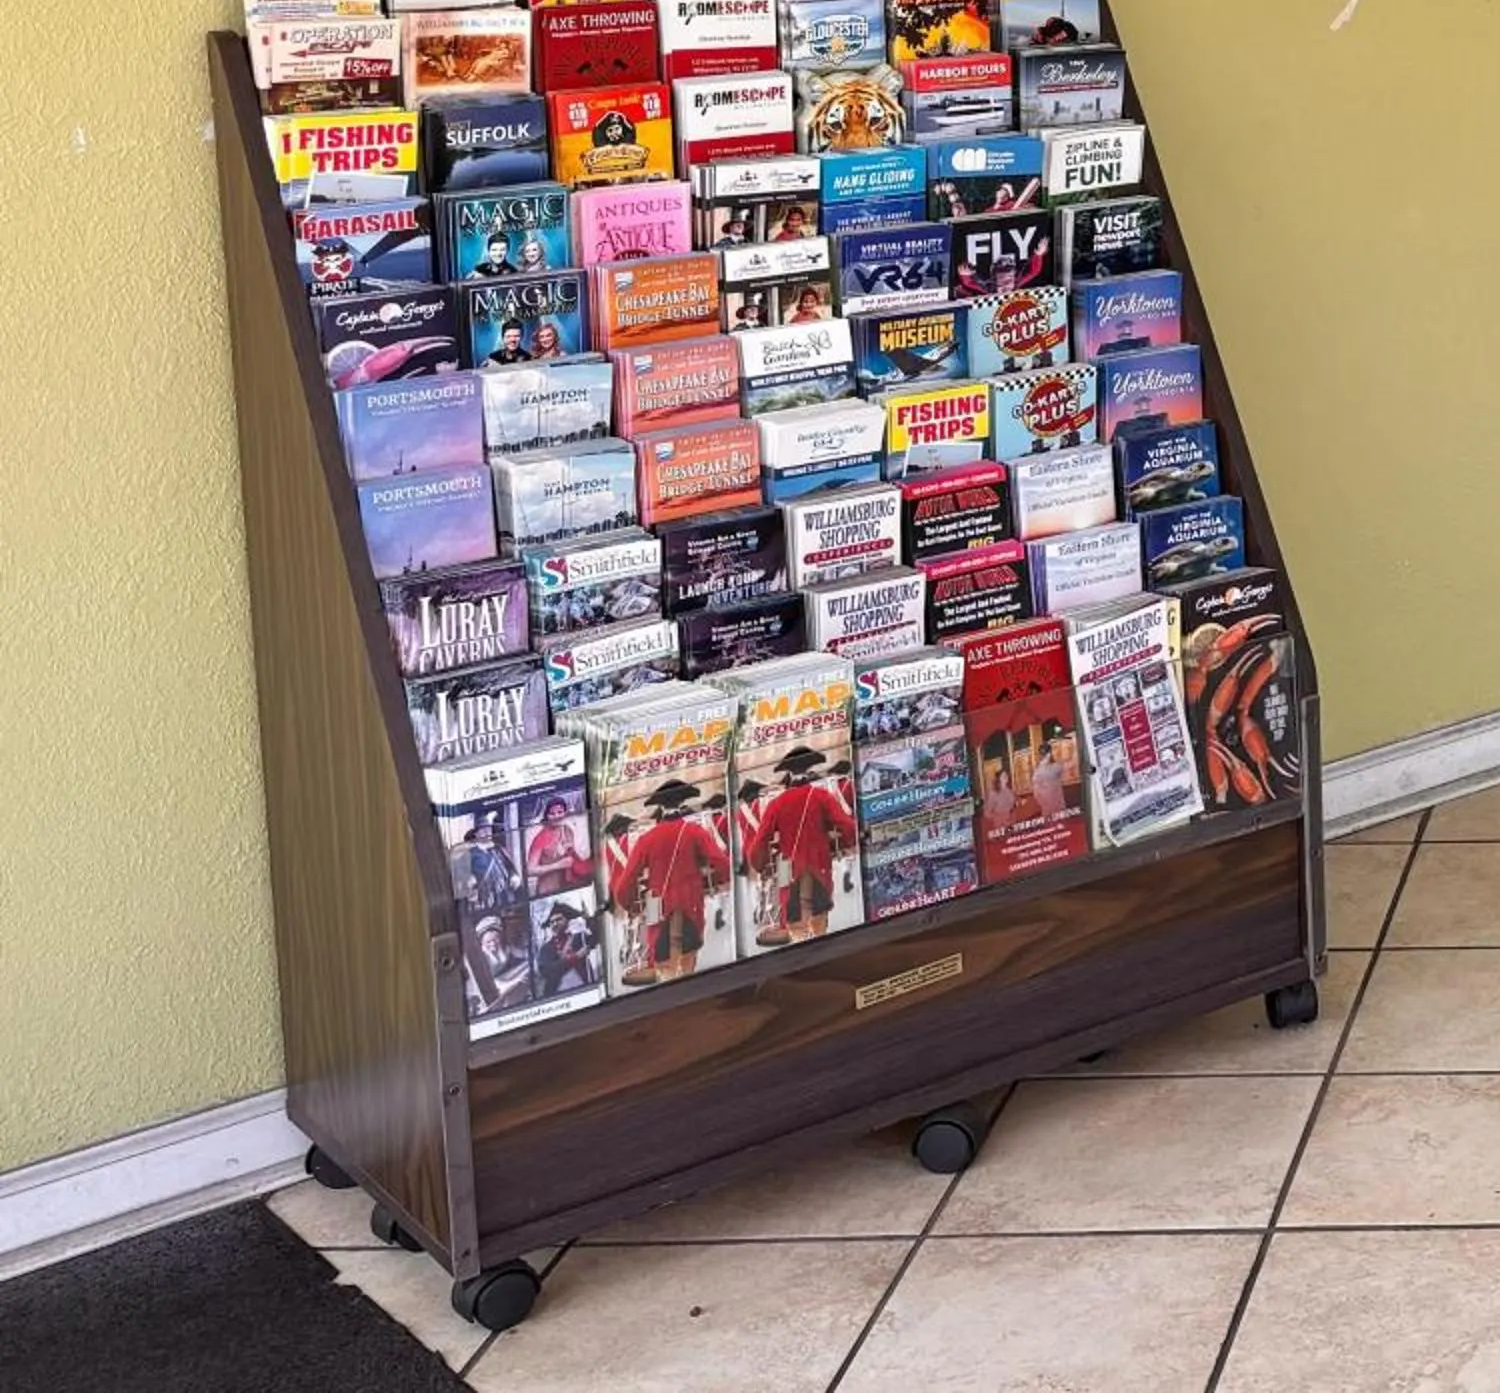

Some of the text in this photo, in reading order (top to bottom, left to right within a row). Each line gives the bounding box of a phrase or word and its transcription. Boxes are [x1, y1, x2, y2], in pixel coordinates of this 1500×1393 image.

[290, 24, 394, 44] OPERATION
[549, 9, 655, 31] AXE THROWING
[805, 21, 869, 42] GLOUCESTER
[918, 62, 1008, 80] HARBOR TOURS
[1040, 60, 1120, 83] Berkeley
[298, 122, 415, 151] FISHING
[445, 122, 530, 147] SUFFOLK
[1065, 138, 1123, 154] ZIPLINE &
[312, 148, 400, 173] TRIPS
[1065, 148, 1123, 166] CLIMBING
[833, 173, 866, 190] HANG
[868, 169, 915, 185] GLIDING
[1064, 162, 1122, 189] FUN!
[461, 194, 565, 226] MAGIC
[595, 197, 683, 220] ANTIQUES
[1093, 212, 1141, 234] VISIT
[302, 209, 417, 242] PARASAIL
[1093, 227, 1141, 242] newport
[861, 243, 903, 254] VIRTUAL
[905, 238, 944, 250] REALITY
[966, 225, 1038, 266] FLY
[474, 279, 577, 314] MAGIC
[616, 282, 711, 314] CHESAPEAKE BAY
[1095, 291, 1175, 326] Yorktown
[879, 317, 918, 331] MILITARY
[879, 324, 955, 352] MUSEUM
[999, 319, 1049, 349] PLUS
[367, 382, 475, 408] PORTSMOUTH
[638, 366, 731, 396] CHESAPEAKE BAY
[1113, 369, 1195, 403] Yorktown
[521, 388, 588, 406] HAMPTON
[896, 391, 987, 427] FISHING
[1029, 399, 1078, 428] PLUS
[907, 416, 976, 445] TRIPS
[1143, 450, 1203, 470] AQUARIUM
[1147, 441, 1197, 459] VIRGINIA
[656, 450, 752, 482] CHESAPEAKE BAY
[372, 475, 482, 504] PORTSMOUTH
[544, 478, 610, 497] HAMPTON
[803, 496, 897, 532] WILLIAMSBURG
[1171, 516, 1223, 534] VIRGINIA
[819, 520, 881, 549] SHOPPING
[1058, 539, 1099, 557] Eastern
[1167, 524, 1228, 544] AQUARIUM
[568, 548, 658, 579] Smithfield
[678, 575, 726, 600] LAUNCH
[827, 580, 921, 617] WILLIAMSBURG
[418, 592, 510, 649] LURAY
[842, 603, 905, 635] SHOPPING
[1075, 608, 1162, 655] WILLIAMSBURG
[419, 634, 506, 674] CAVERNS
[574, 633, 663, 672] Smithfield
[967, 627, 1063, 664] AXE THROWING
[1091, 630, 1150, 668] SHOPPING
[880, 660, 962, 692] Smithfield
[435, 685, 527, 744] LURAY
[698, 705, 729, 721] FREE
[754, 681, 851, 723] MAP
[627, 719, 731, 758] MAP
[765, 709, 847, 739] COUPONS
[635, 744, 726, 775] COUPONS
